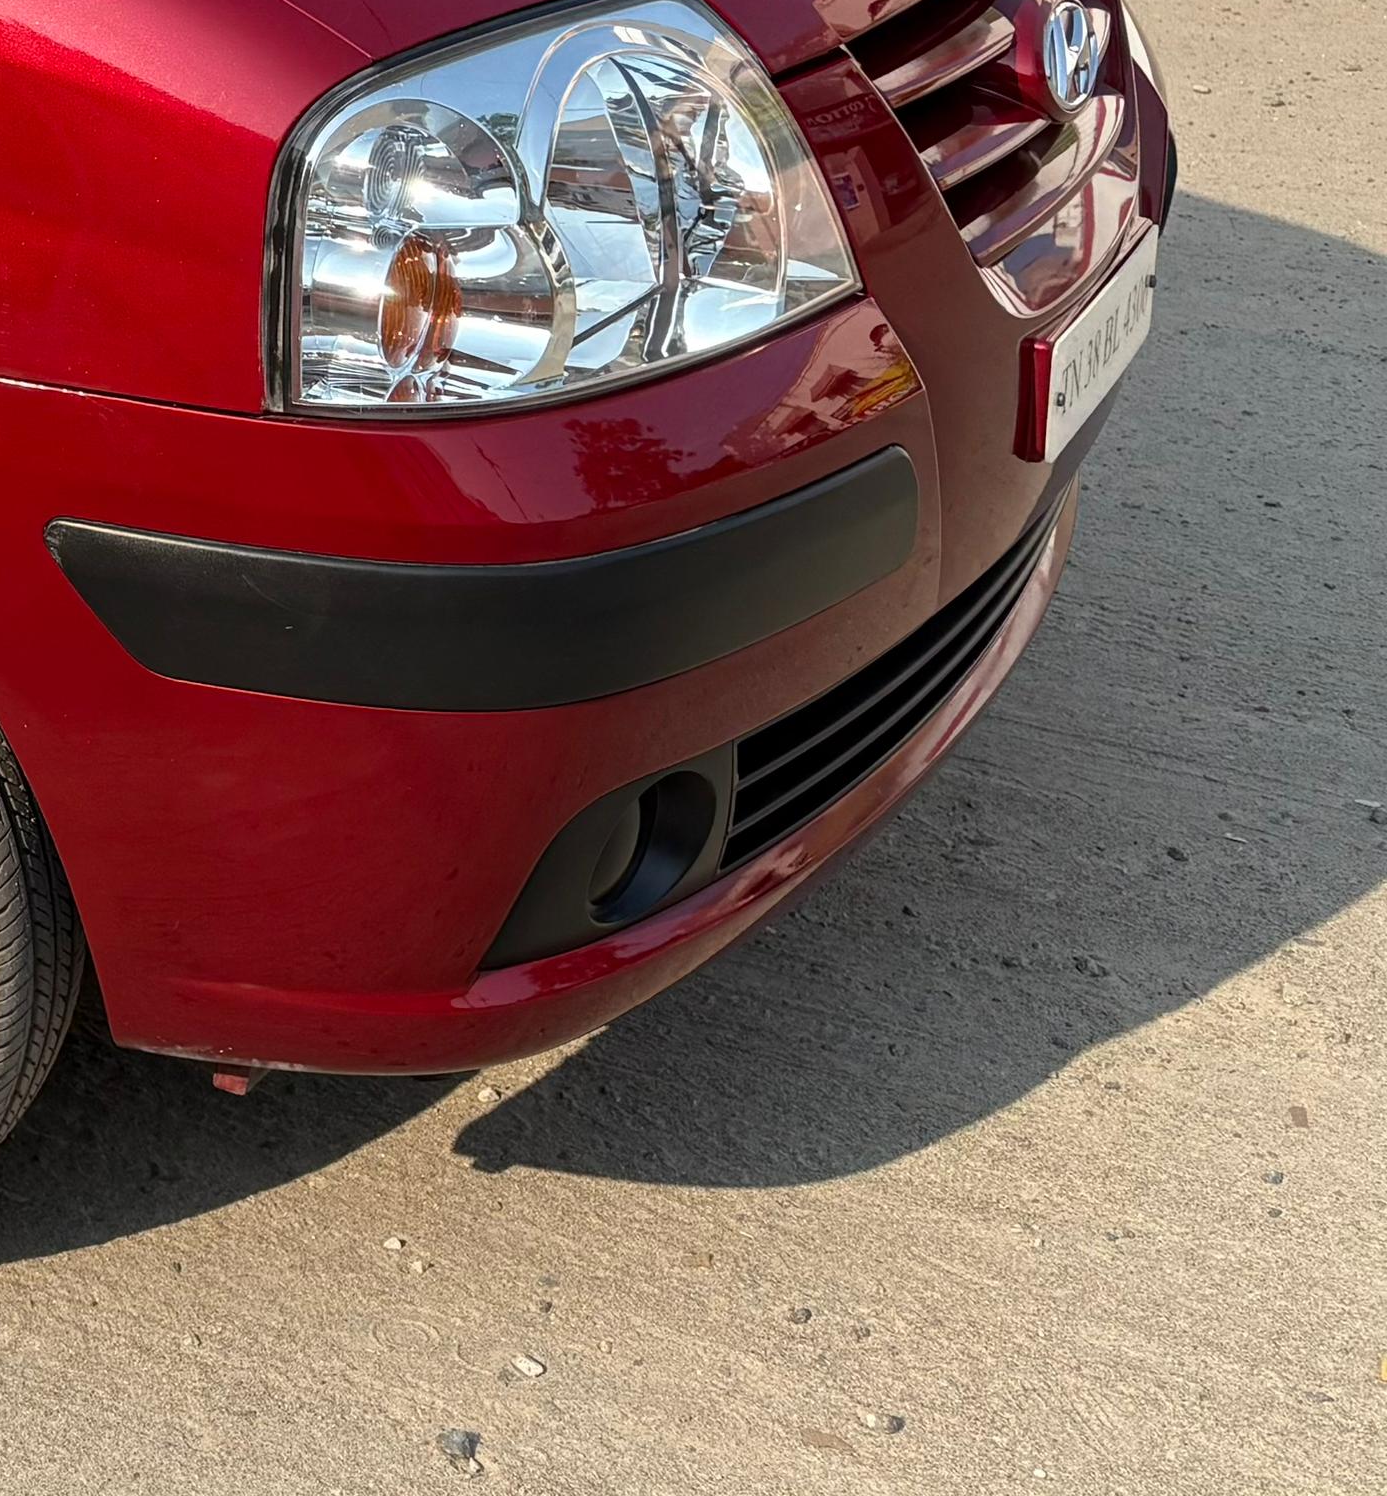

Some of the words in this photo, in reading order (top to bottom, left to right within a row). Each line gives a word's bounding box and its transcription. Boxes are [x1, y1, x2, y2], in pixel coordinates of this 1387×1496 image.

[1061, 349, 1083, 416] TN
[1083, 328, 1103, 390] 38
[1102, 303, 1121, 368] BL
